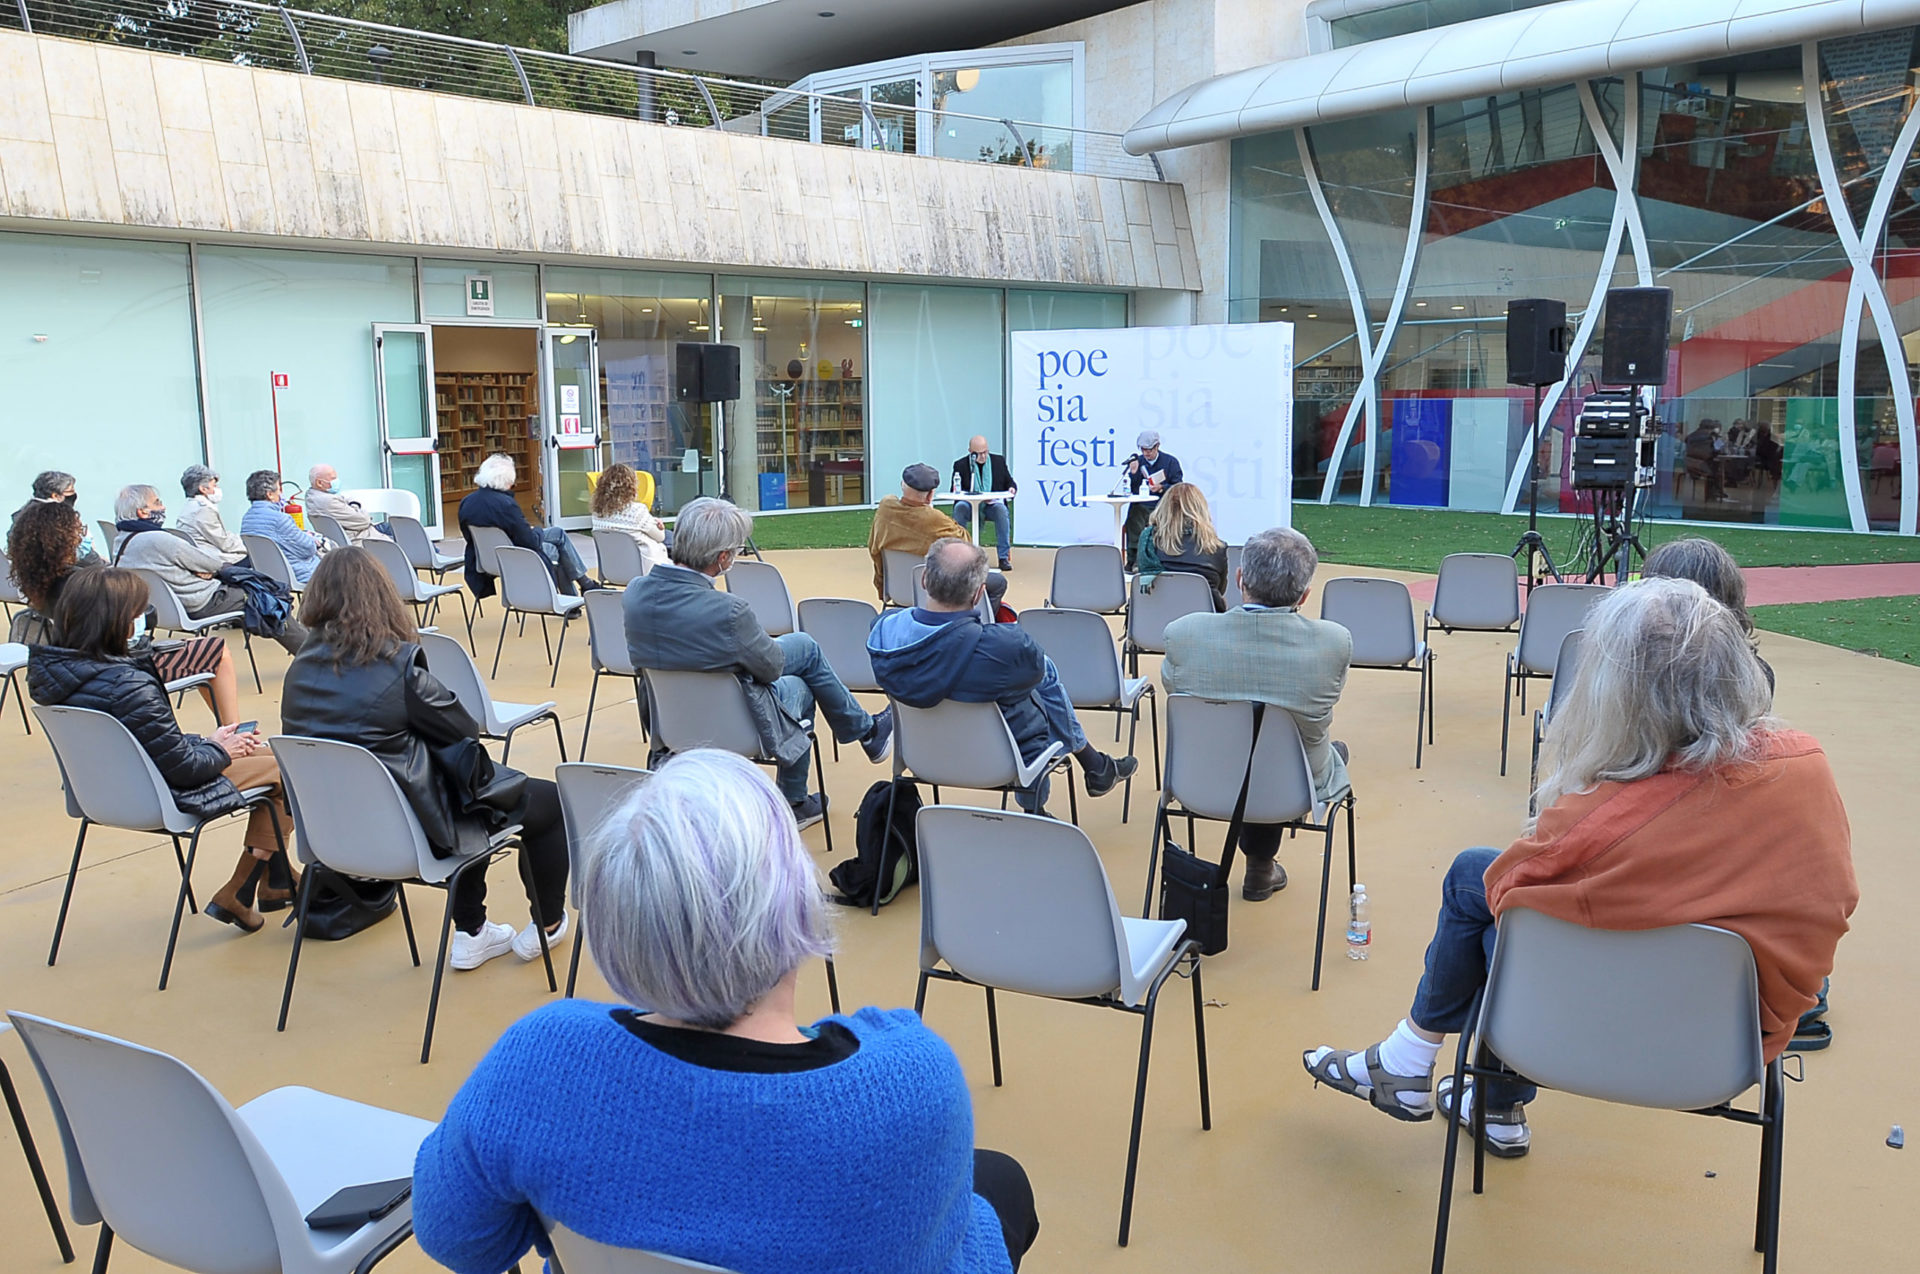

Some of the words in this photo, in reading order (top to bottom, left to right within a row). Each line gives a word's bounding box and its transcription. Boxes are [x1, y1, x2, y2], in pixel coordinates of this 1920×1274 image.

[1036, 349, 1108, 391] poe
[1037, 384, 1089, 423] sia
[1137, 370, 1221, 430] sia
[1036, 426, 1117, 468] festi
[1036, 468, 1091, 508] val
